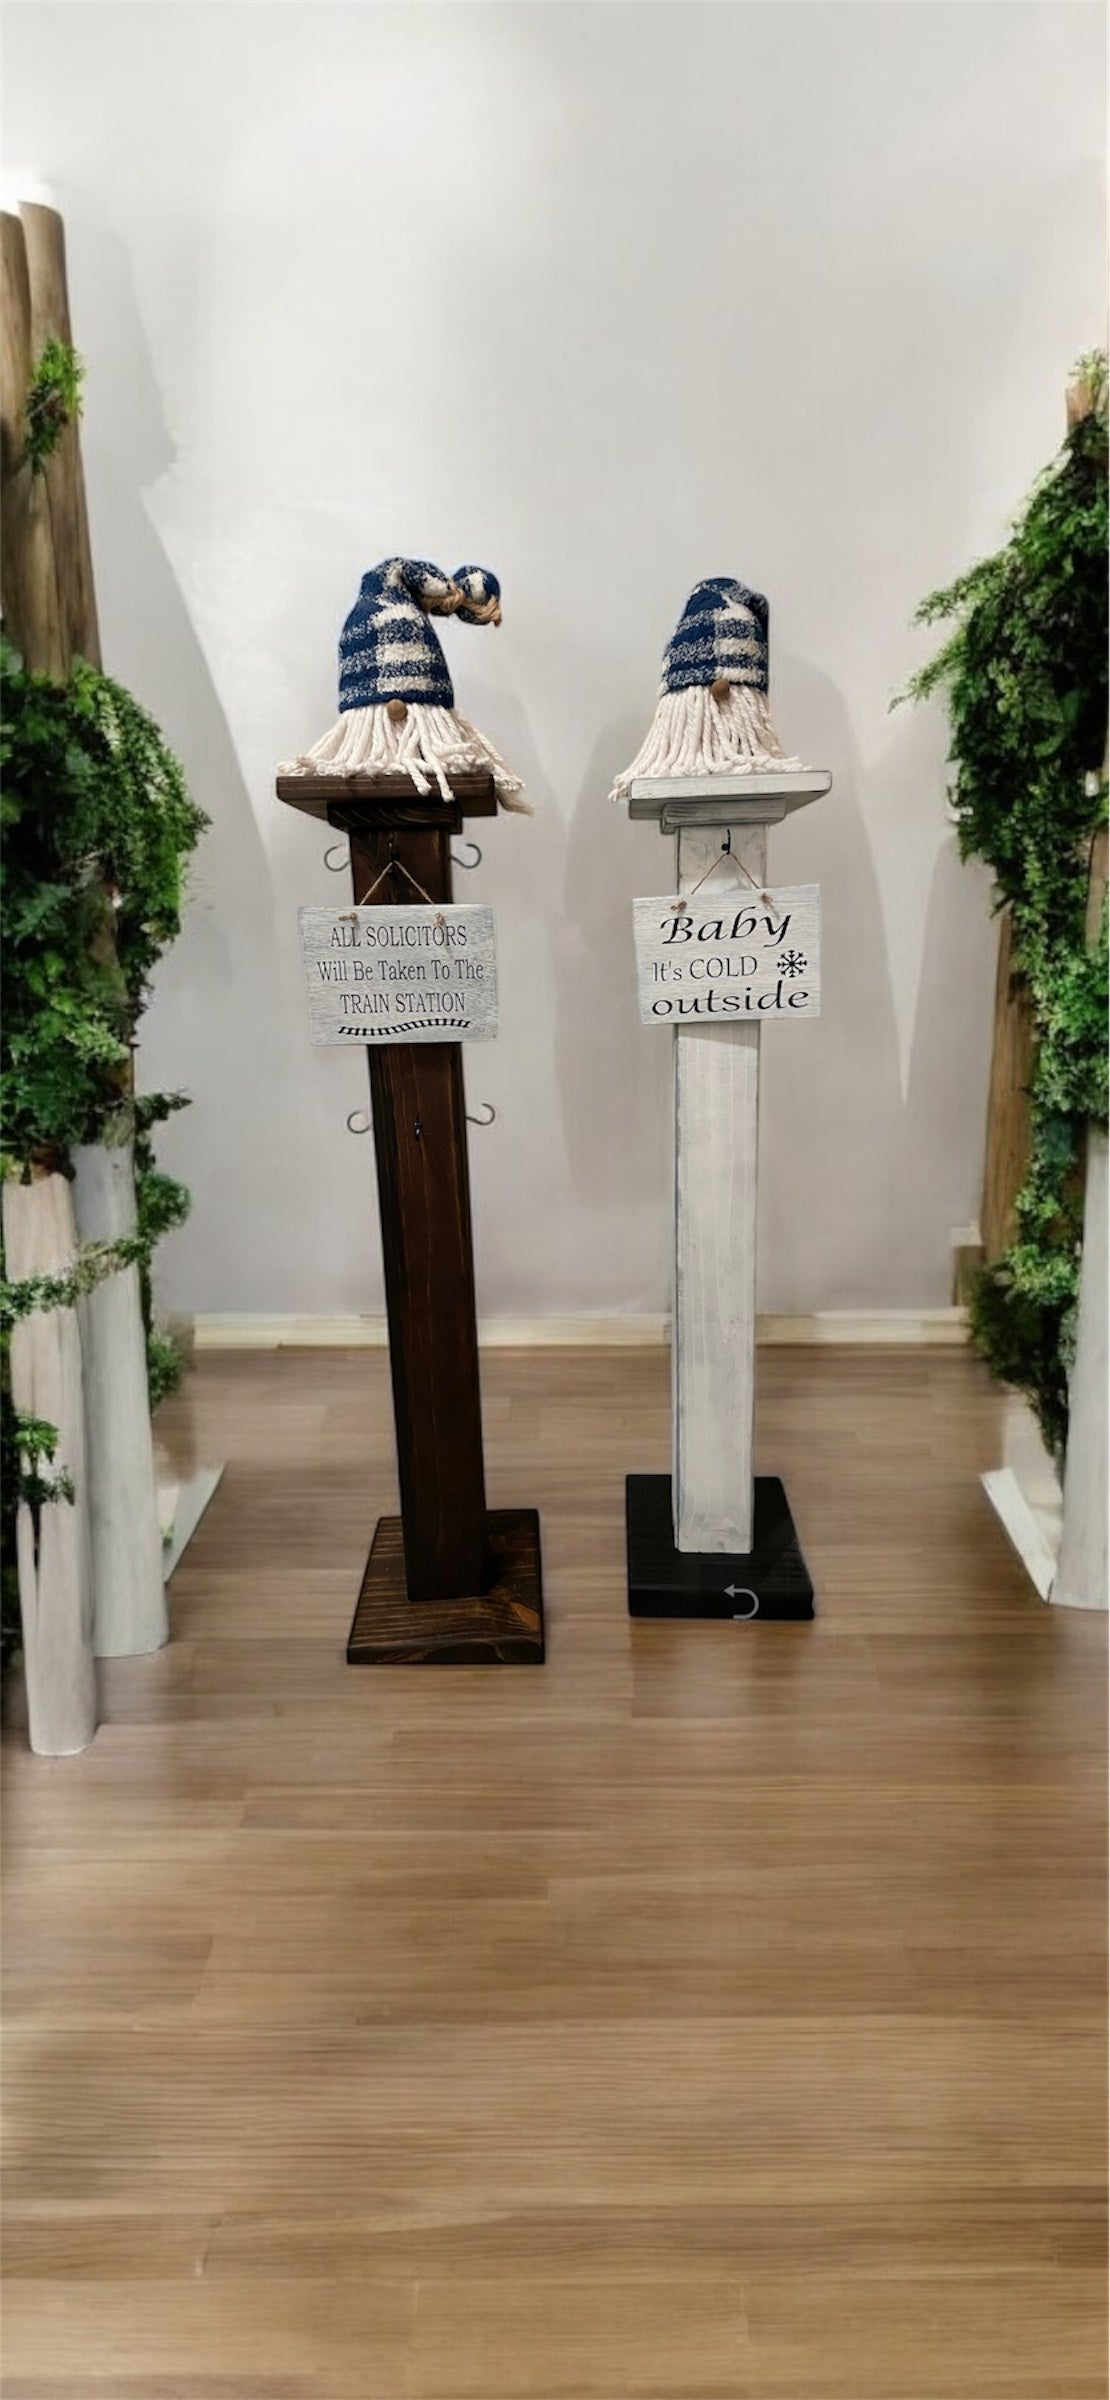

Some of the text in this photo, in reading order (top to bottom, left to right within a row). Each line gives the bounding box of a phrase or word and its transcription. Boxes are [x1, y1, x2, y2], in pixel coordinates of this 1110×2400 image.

[331, 925, 468, 947] ALL SOLICITORS
[659, 906, 792, 948] Baby
[317, 958, 484, 982] Will Be Taken To The
[652, 955, 758, 982] It's COLD
[340, 992, 466, 1014] TRAIN STATION
[651, 979, 809, 1016] outside
